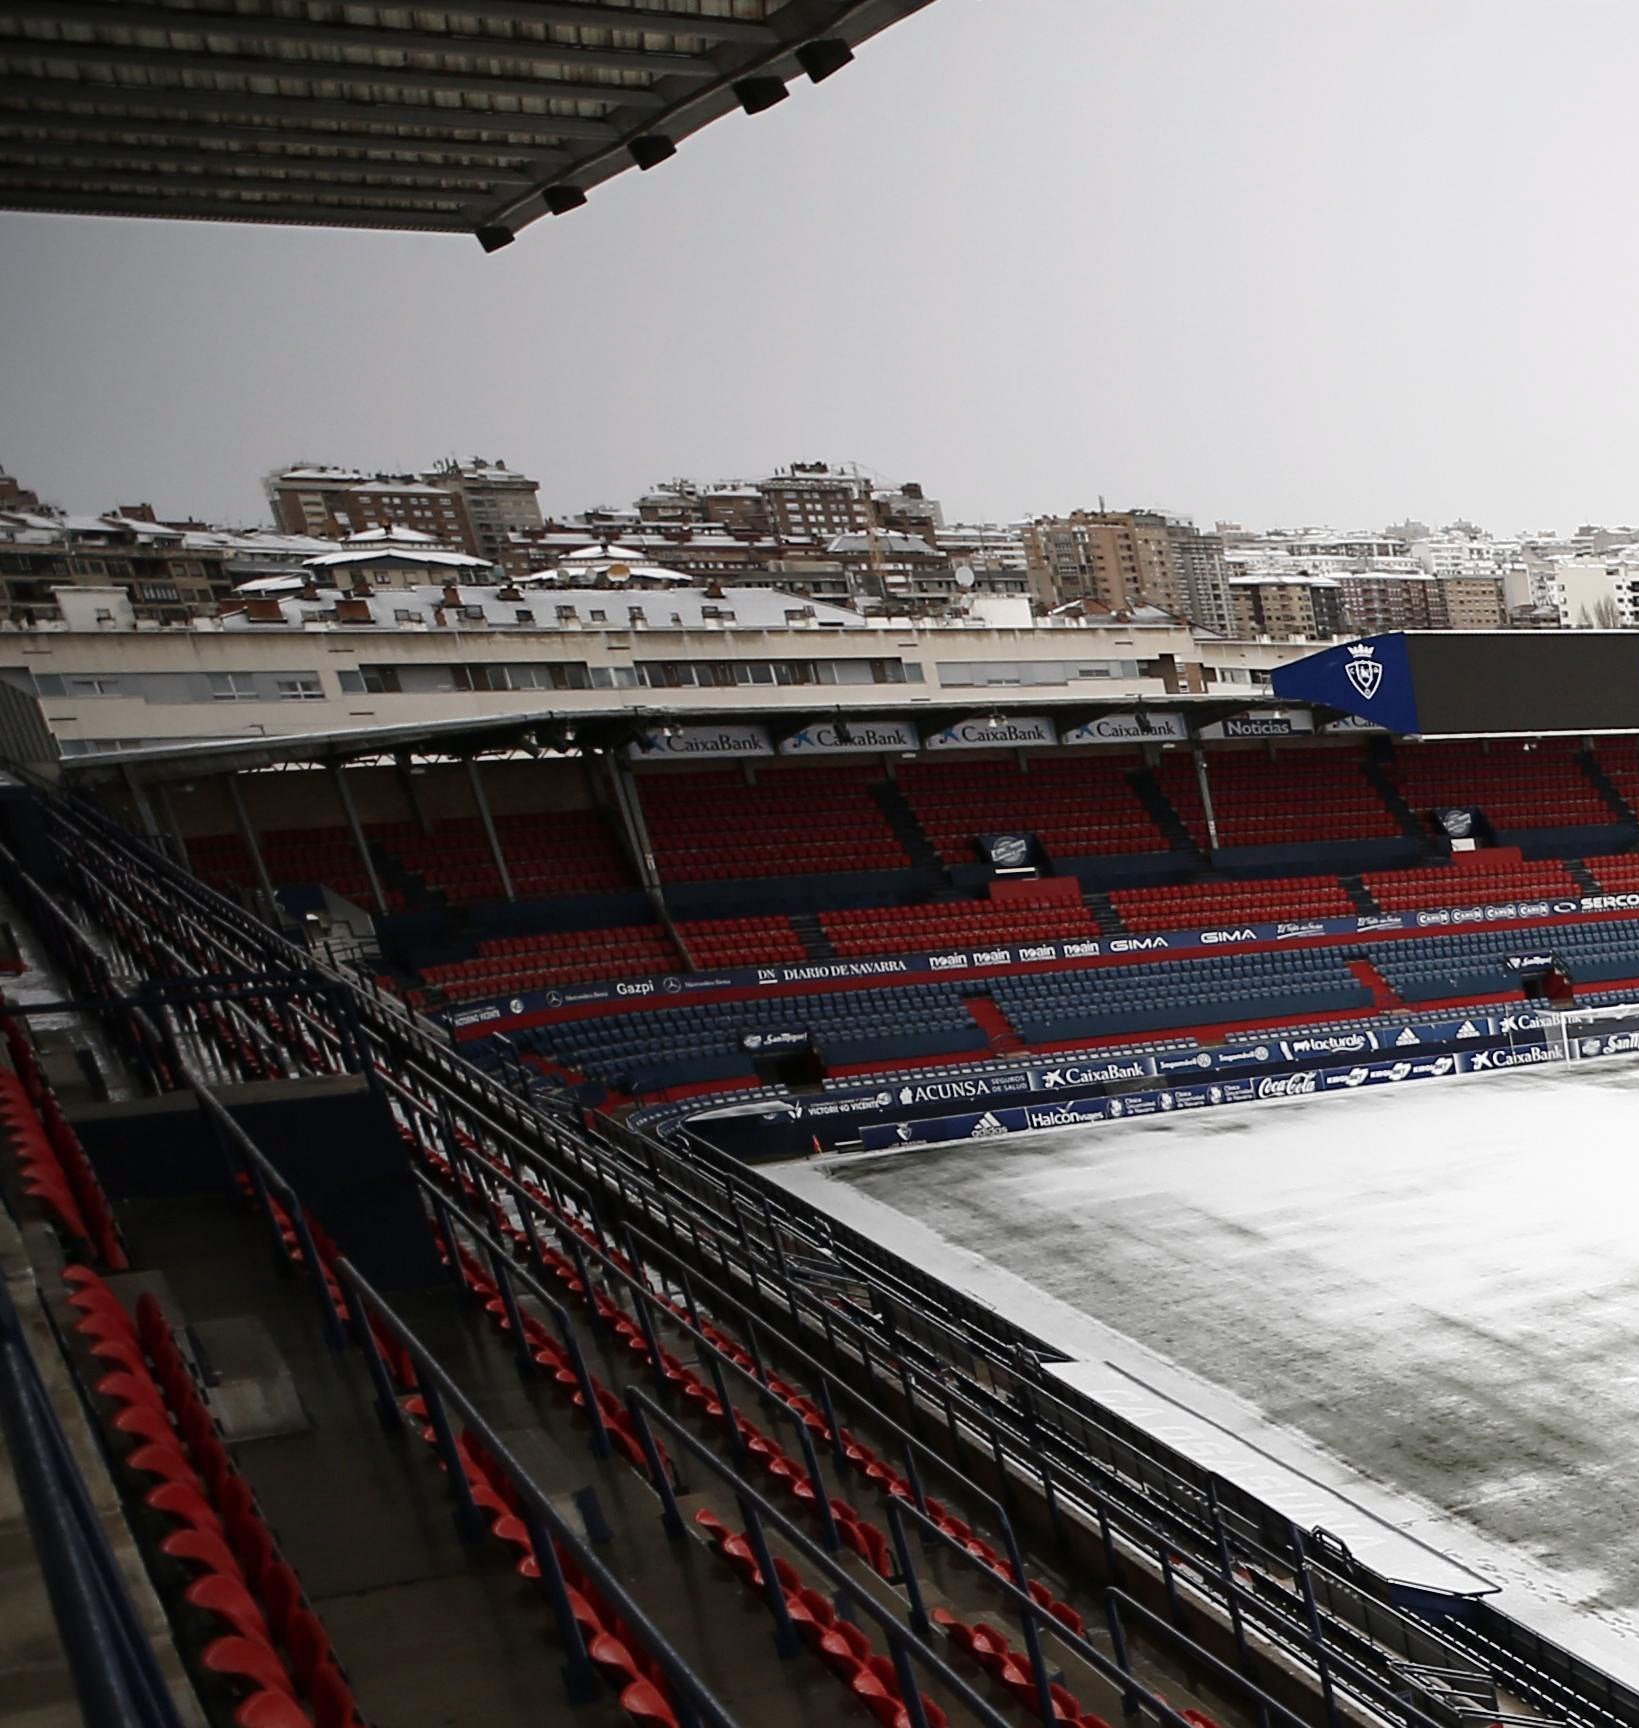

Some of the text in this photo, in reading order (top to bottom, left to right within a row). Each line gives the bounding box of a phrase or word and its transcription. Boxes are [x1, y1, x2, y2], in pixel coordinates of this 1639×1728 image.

[961, 723, 1046, 743] CaixaBank
[1226, 719, 1290, 737] Noticias
[666, 733, 763, 754] CaixaBank
[1110, 935, 1168, 952] GIMA
[1201, 928, 1257, 944] GIMA
[757, 968, 775, 980] DN
[783, 960, 906, 981] DIARIO DE NAVARRA
[616, 979, 654, 996] Gazpi
[1492, 1045, 1564, 1067] CaixaBank
[1065, 1059, 1144, 1084] CaixaBank
[913, 1079, 990, 1102] ACUNSA
